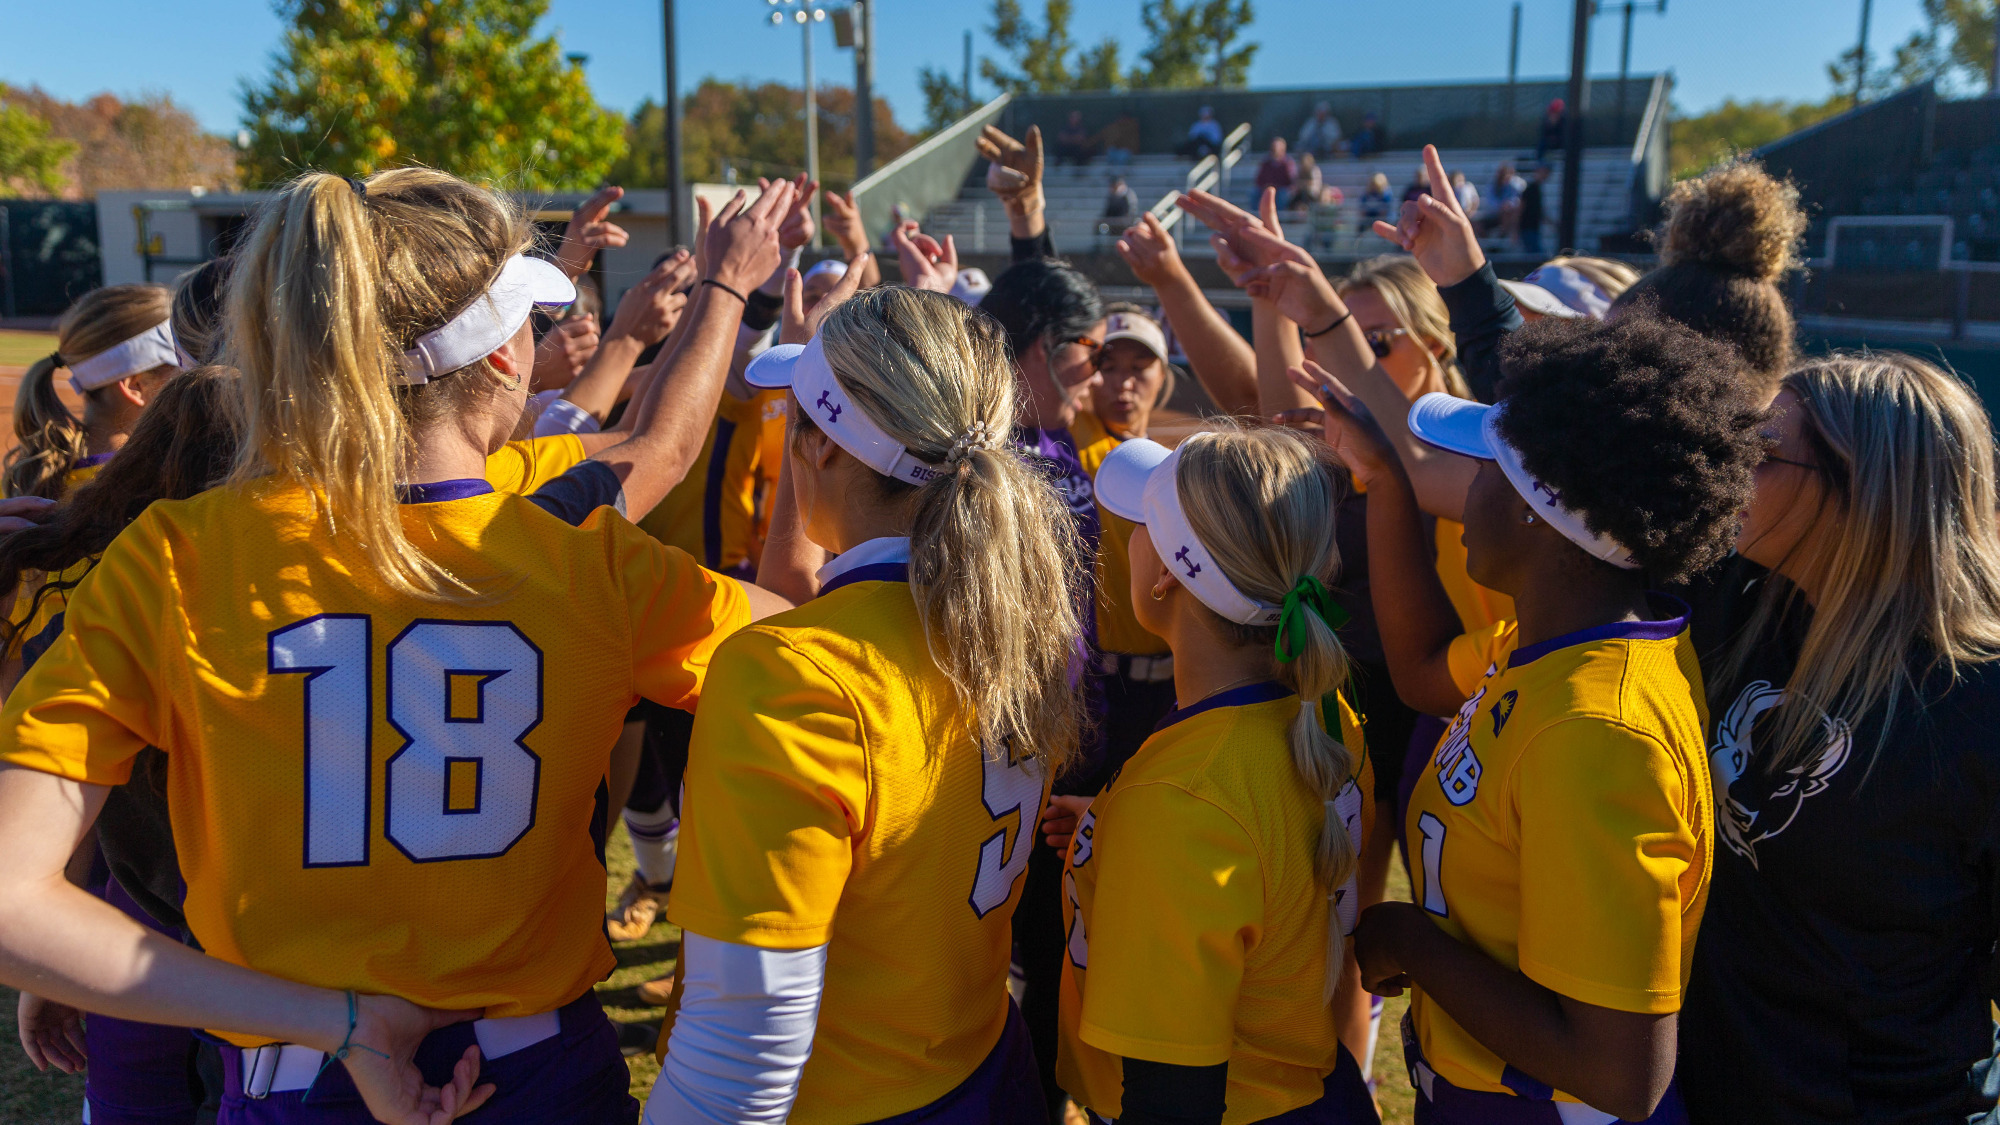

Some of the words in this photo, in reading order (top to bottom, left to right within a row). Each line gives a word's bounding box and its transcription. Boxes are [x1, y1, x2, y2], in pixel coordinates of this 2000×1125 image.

[1115, 314, 1130, 331] L
[267, 612, 544, 869] 18
[1418, 810, 1449, 919] 1
